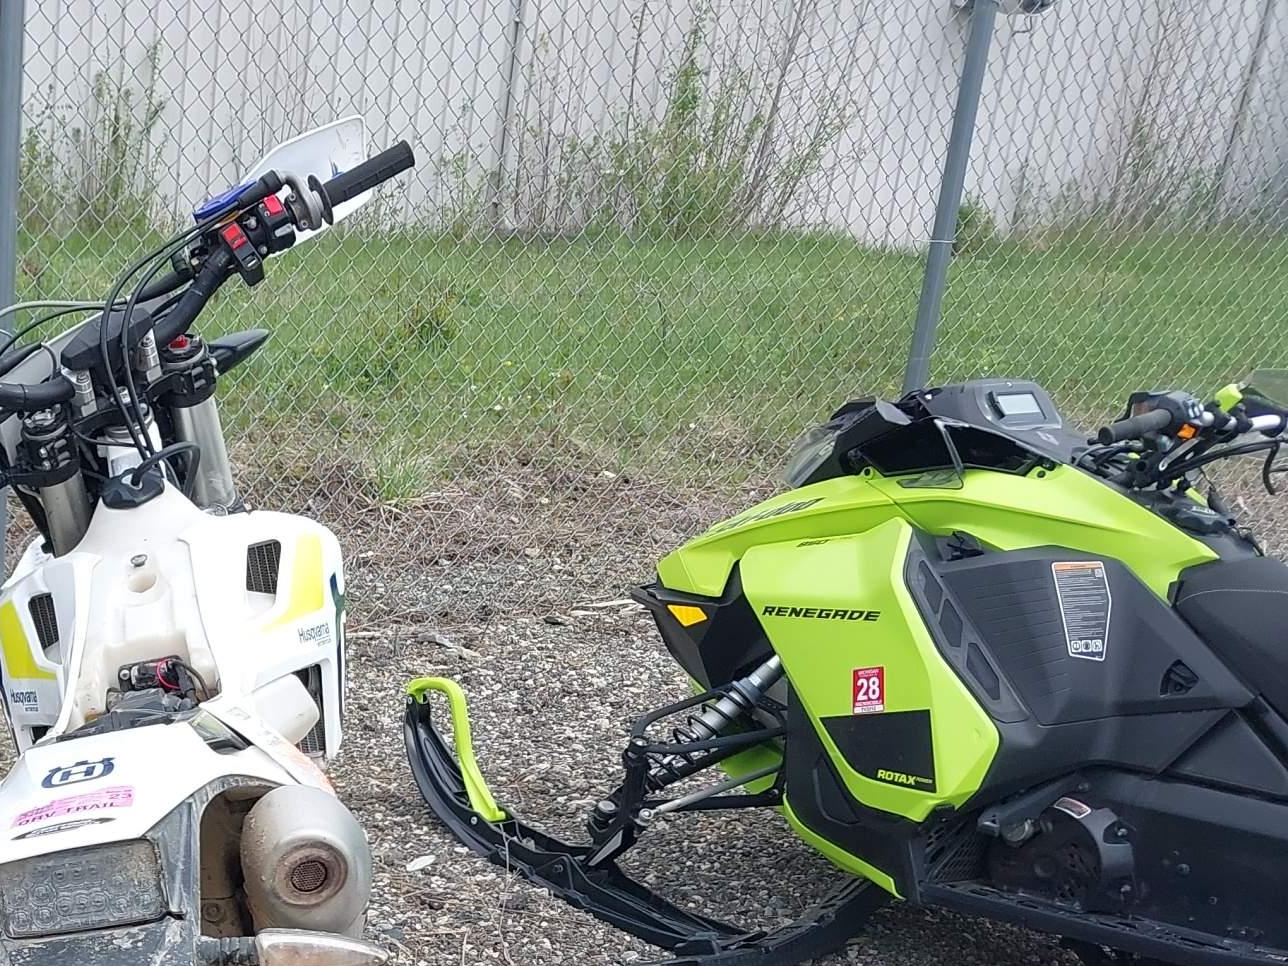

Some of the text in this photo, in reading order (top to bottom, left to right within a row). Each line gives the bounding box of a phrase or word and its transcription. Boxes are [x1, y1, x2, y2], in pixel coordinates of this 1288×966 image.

[762, 606, 881, 622] RENEGADE
[297, 622, 330, 643] Husqvarna
[10, 688, 38, 706] Husqvarna
[856, 676, 880, 701] 28
[877, 769, 916, 786] ROTAX
